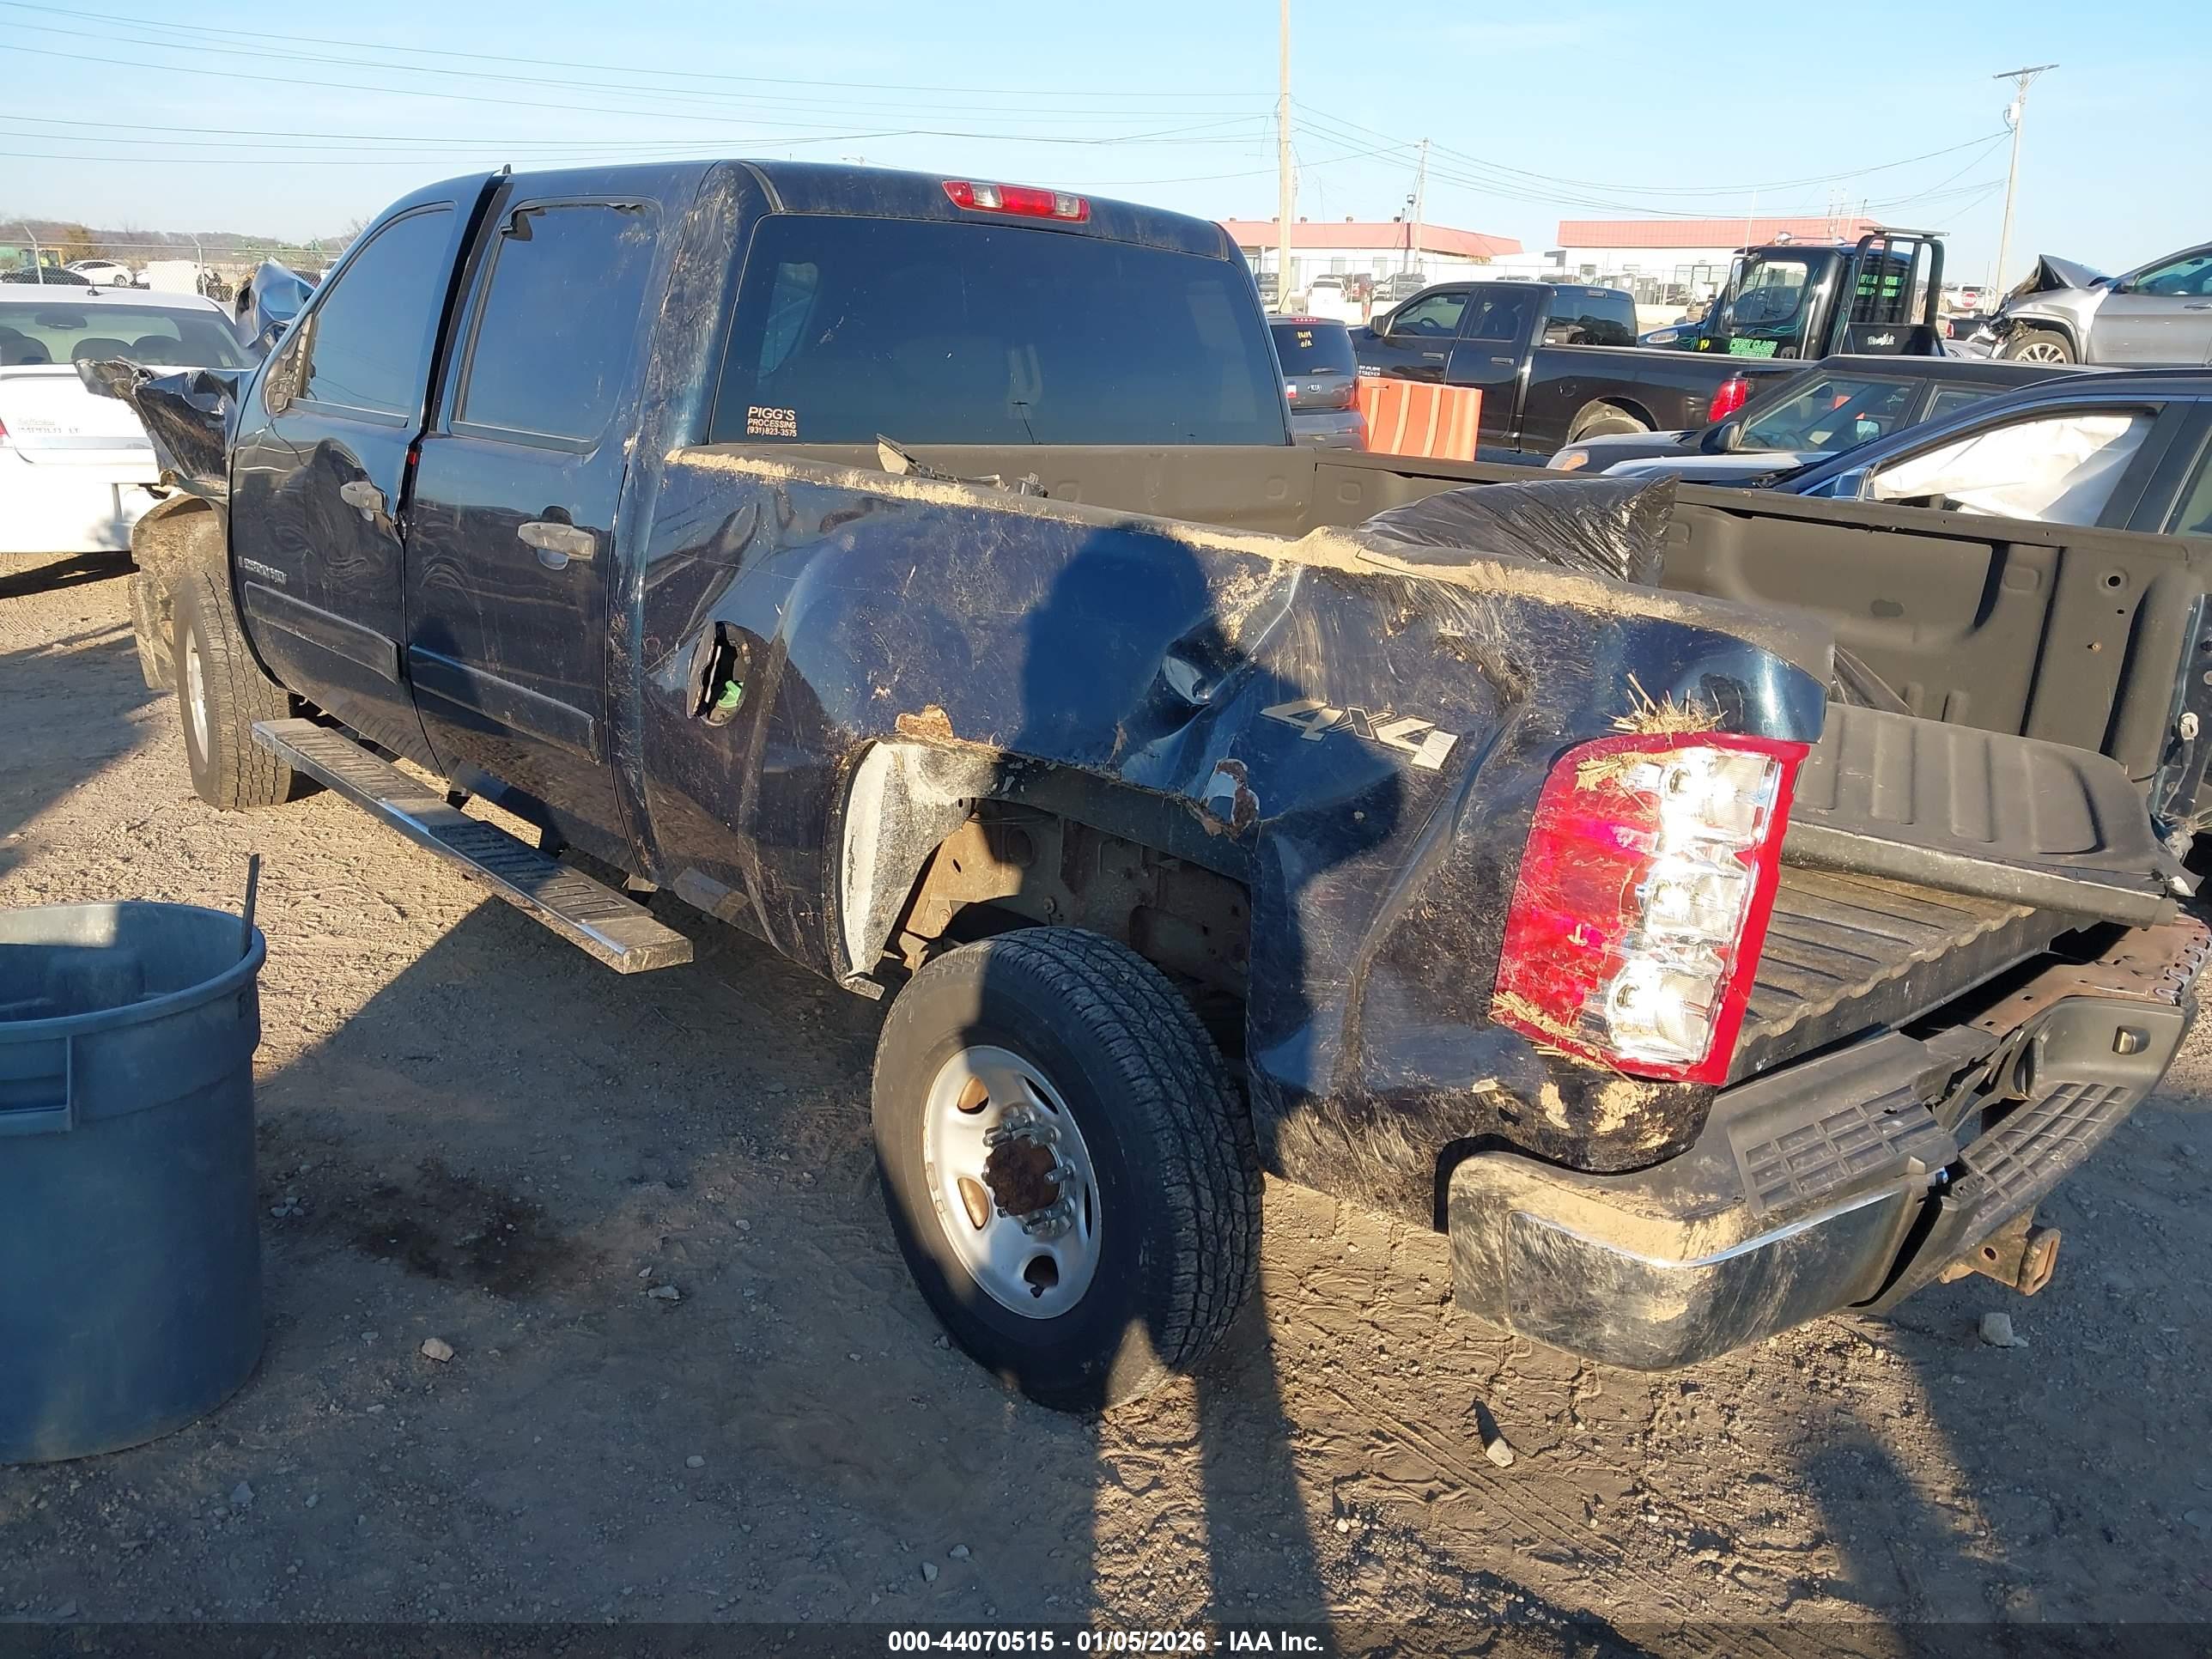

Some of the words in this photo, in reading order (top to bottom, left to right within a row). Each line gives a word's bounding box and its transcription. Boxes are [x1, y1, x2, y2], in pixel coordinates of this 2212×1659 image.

[1730, 337, 1753, 350] FIRST
[1753, 339, 1778, 352] CLASS
[748, 406, 796, 421] PIGG'S
[747, 417, 797, 429] PROCESSING
